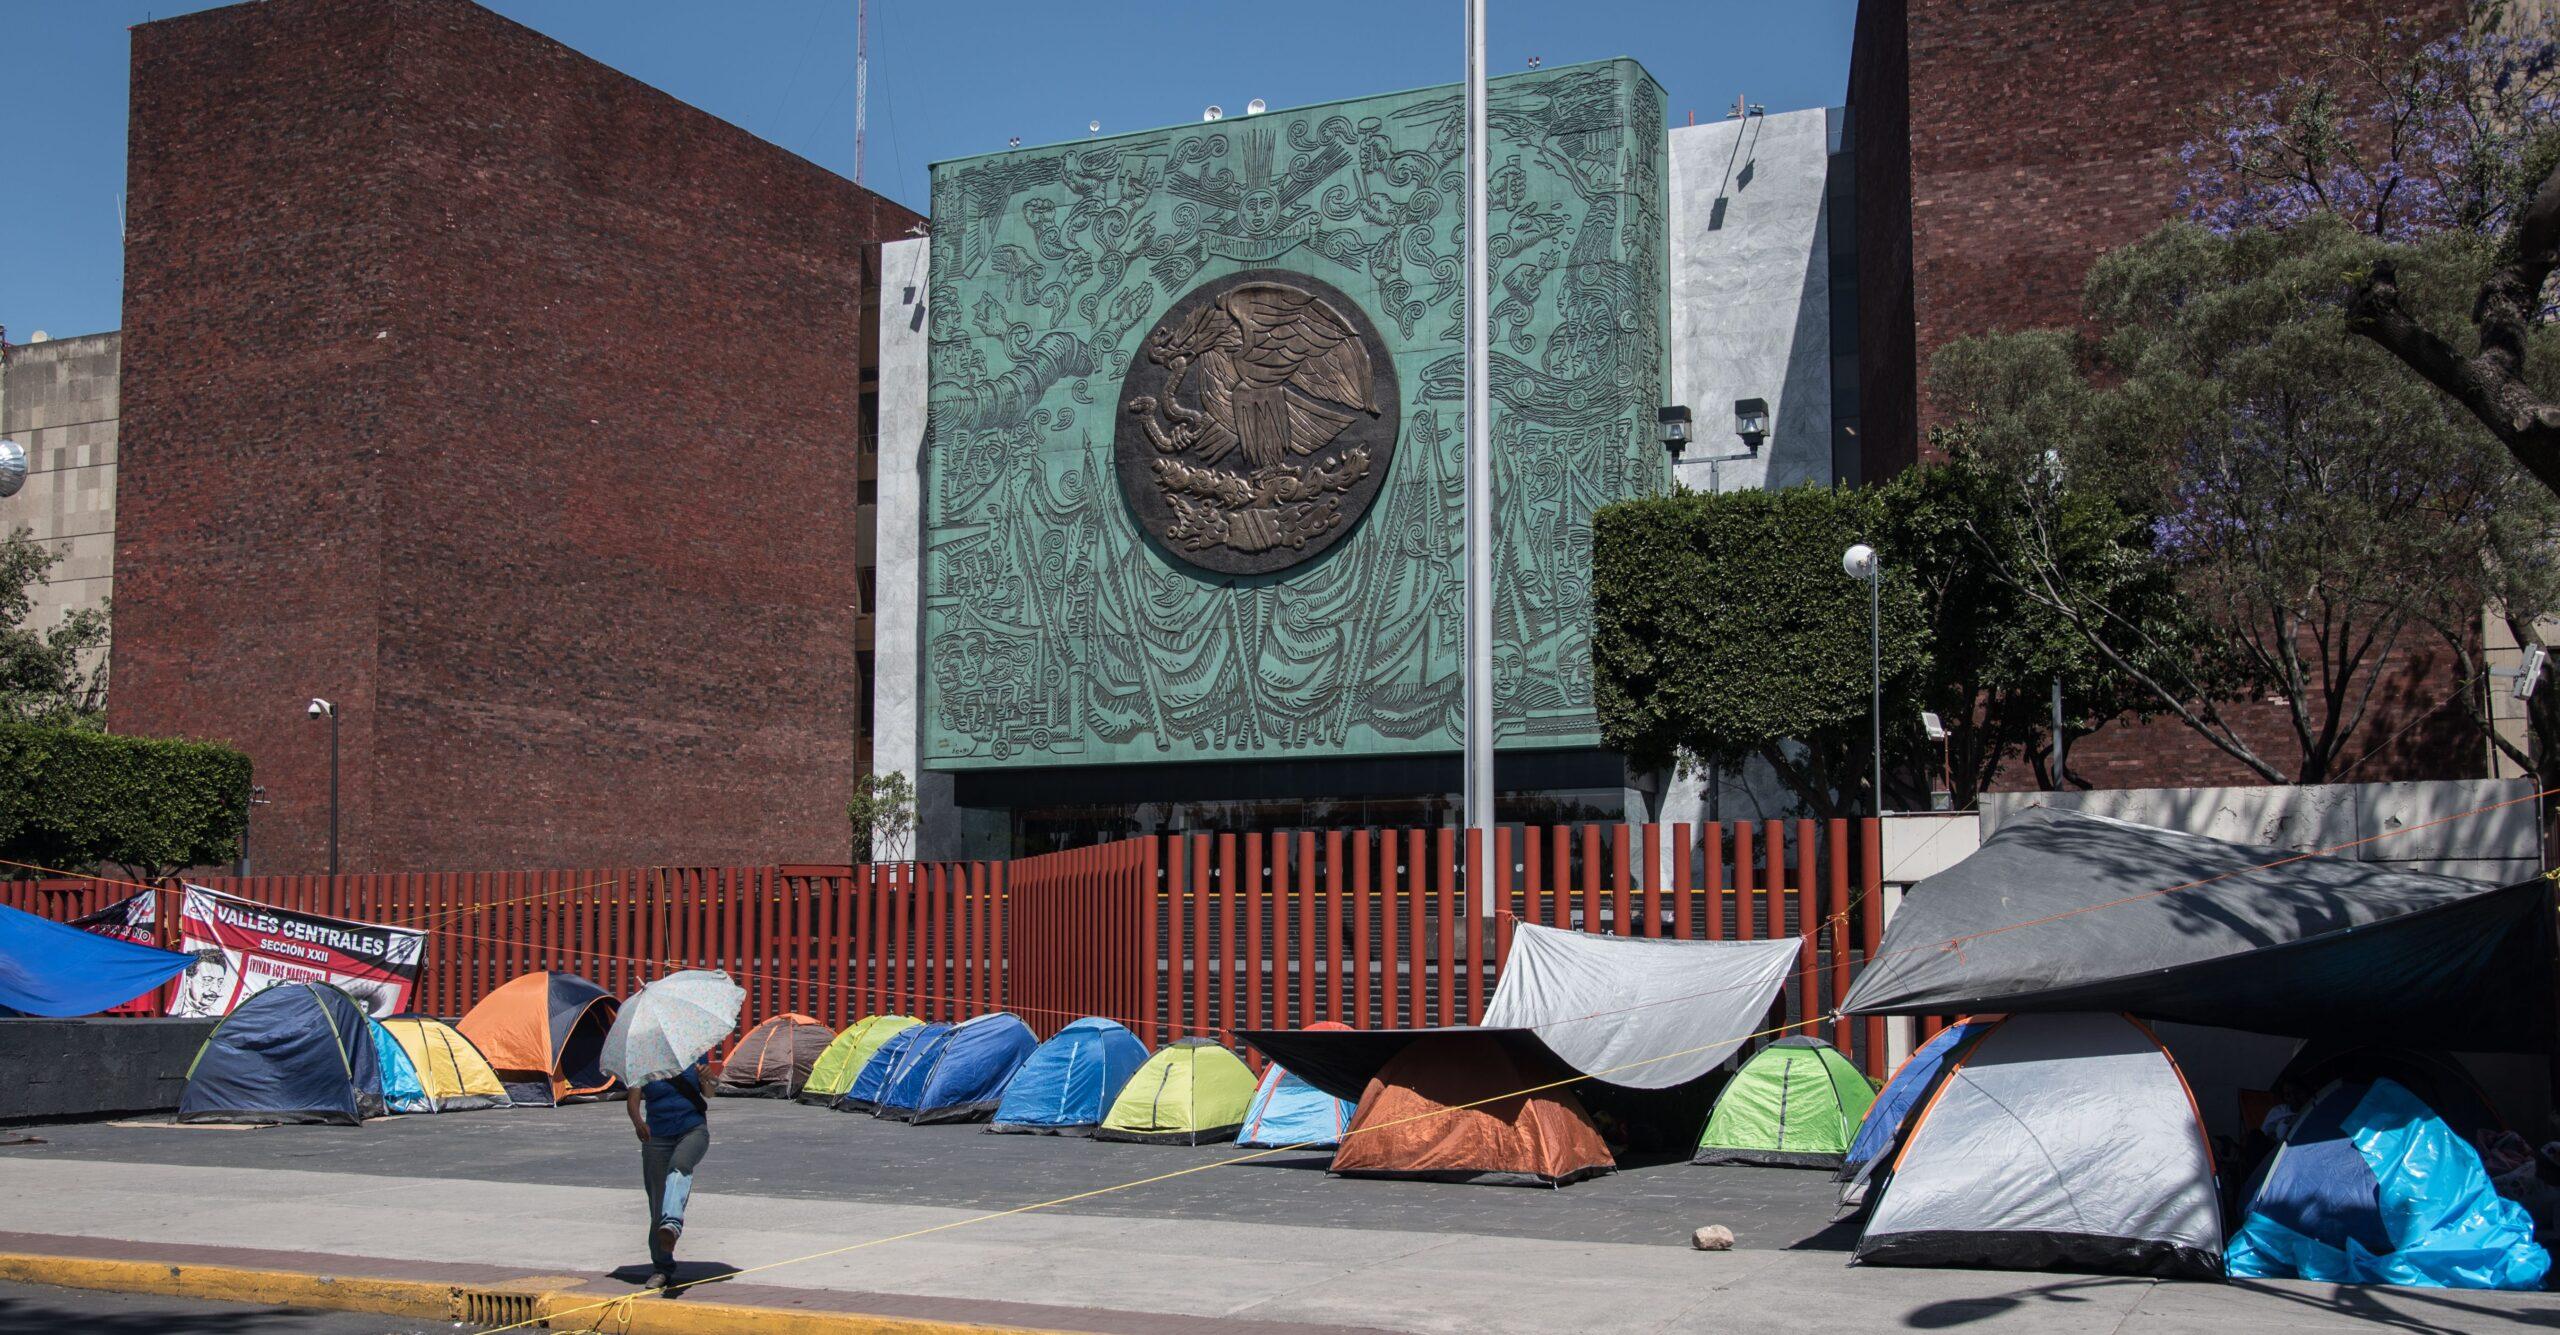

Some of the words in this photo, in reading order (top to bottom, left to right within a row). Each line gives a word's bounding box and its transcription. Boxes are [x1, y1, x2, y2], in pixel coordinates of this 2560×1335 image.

[217, 905, 279, 934] VALLES
[283, 920, 384, 955] CENTRALES
[260, 939, 305, 957] SECCIÓN
[307, 948, 329, 962] XXII
[272, 963, 285, 978] LOS
